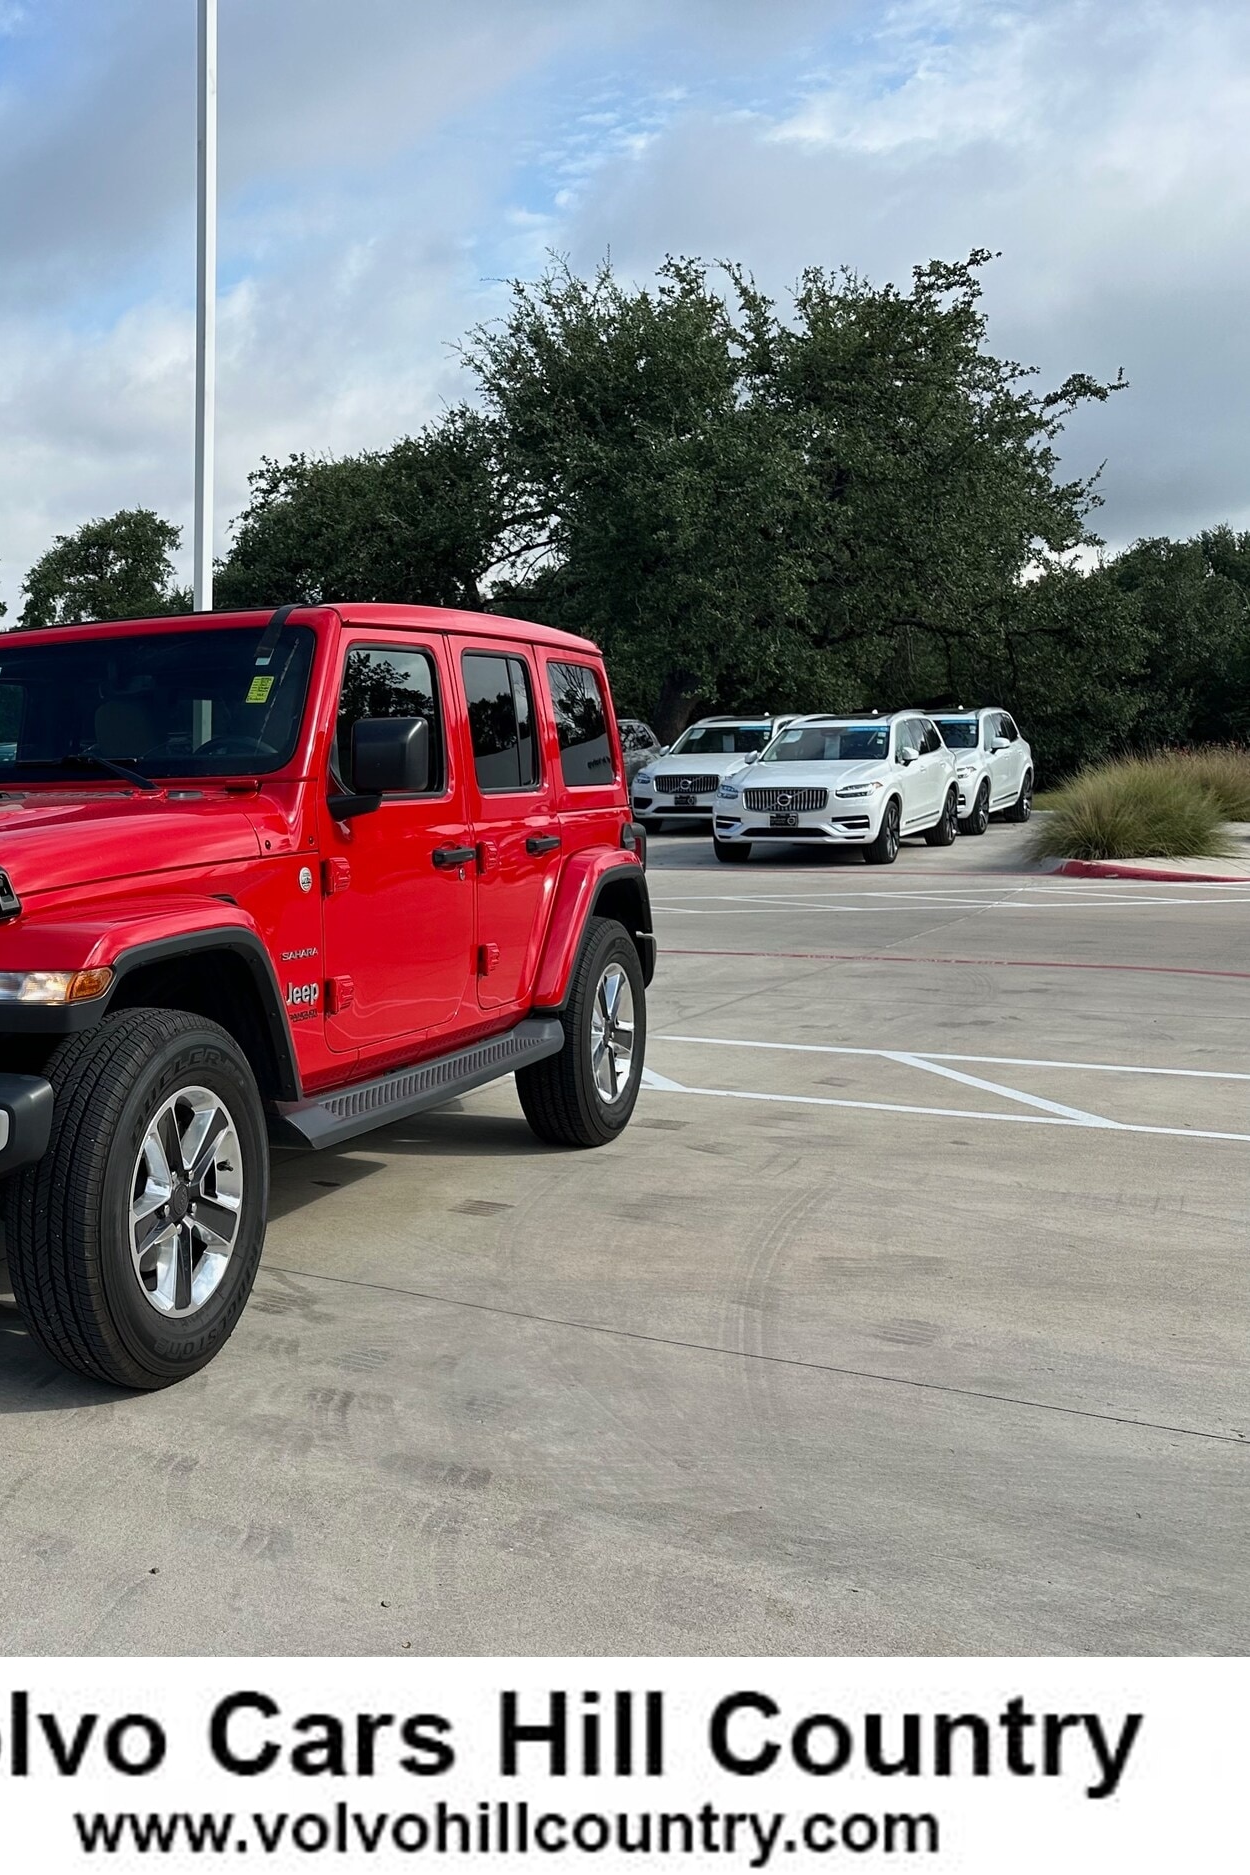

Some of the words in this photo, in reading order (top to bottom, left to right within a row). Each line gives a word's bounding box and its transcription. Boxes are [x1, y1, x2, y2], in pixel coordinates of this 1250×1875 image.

[281, 947, 318, 961] SAHARA
[285, 981, 320, 1006] Jeep
[153, 1224, 262, 1359] RIDGESTONE
